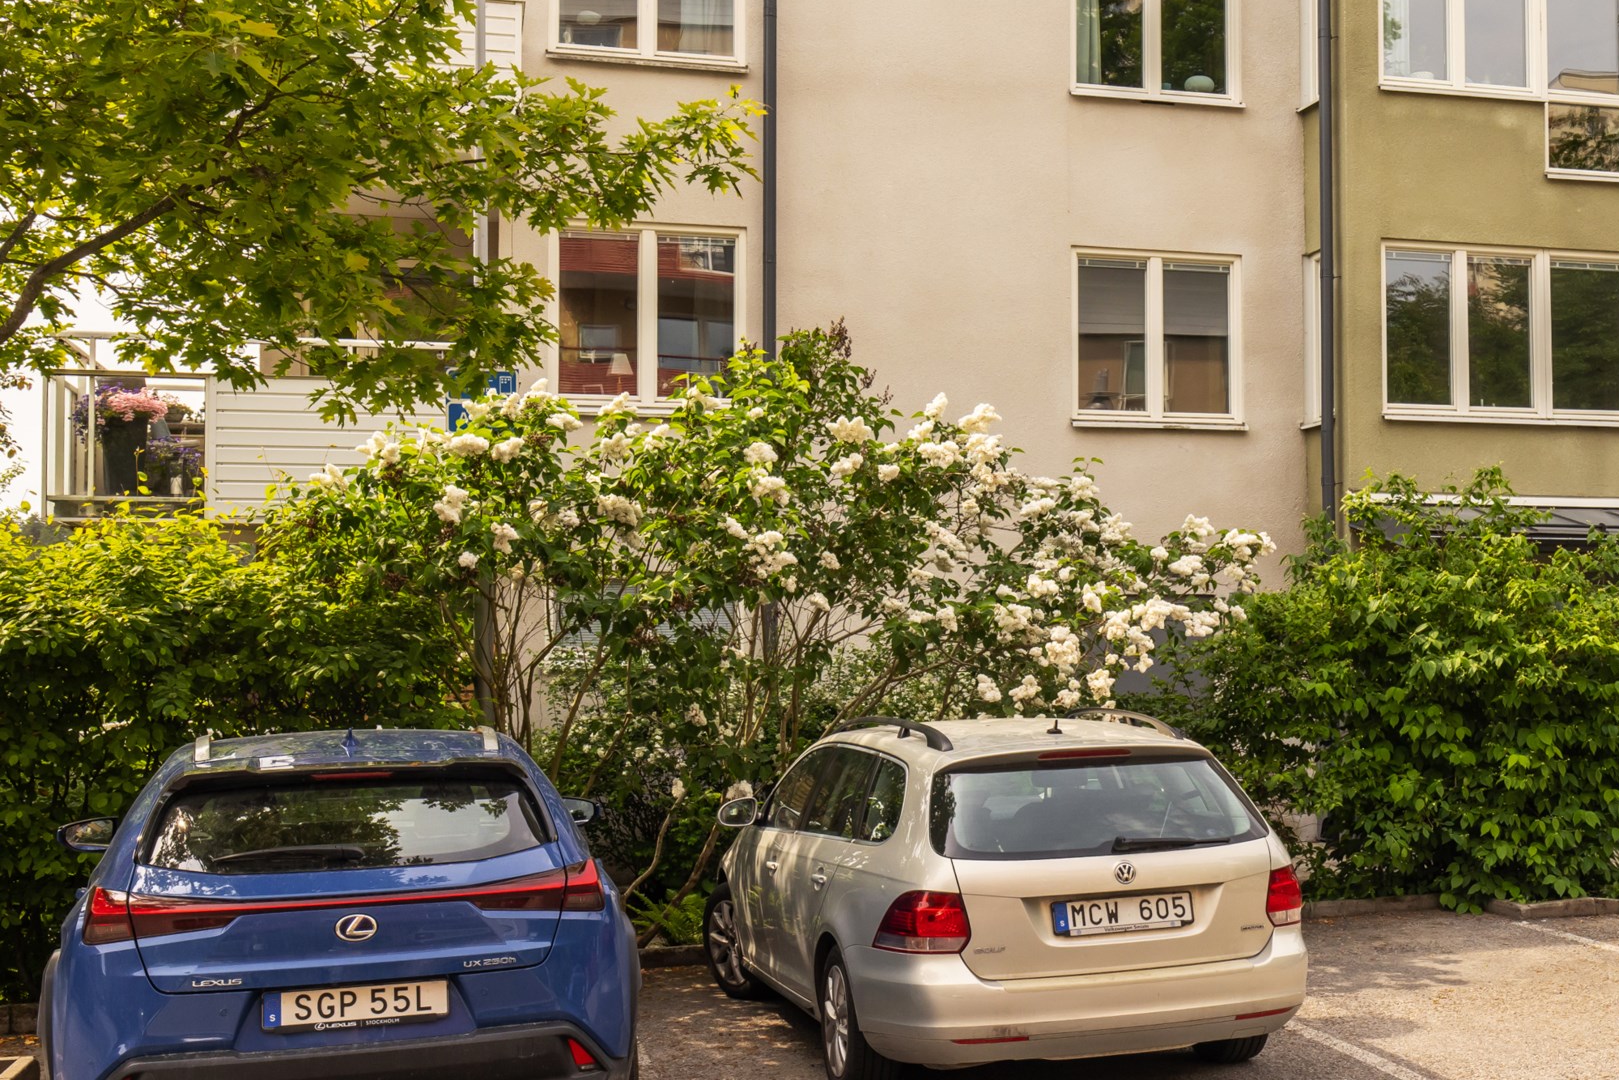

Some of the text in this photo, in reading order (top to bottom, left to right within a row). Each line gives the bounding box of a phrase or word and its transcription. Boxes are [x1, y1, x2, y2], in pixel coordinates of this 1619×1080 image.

[1071, 896, 1186, 927] MCW 605
[463, 959, 482, 968] UX
[192, 978, 242, 988] LEXUS
[294, 985, 432, 1021] SGP 55L
[269, 1014, 276, 1022] S
[326, 1018, 400, 1029] LEXUS STOCKHOLM
